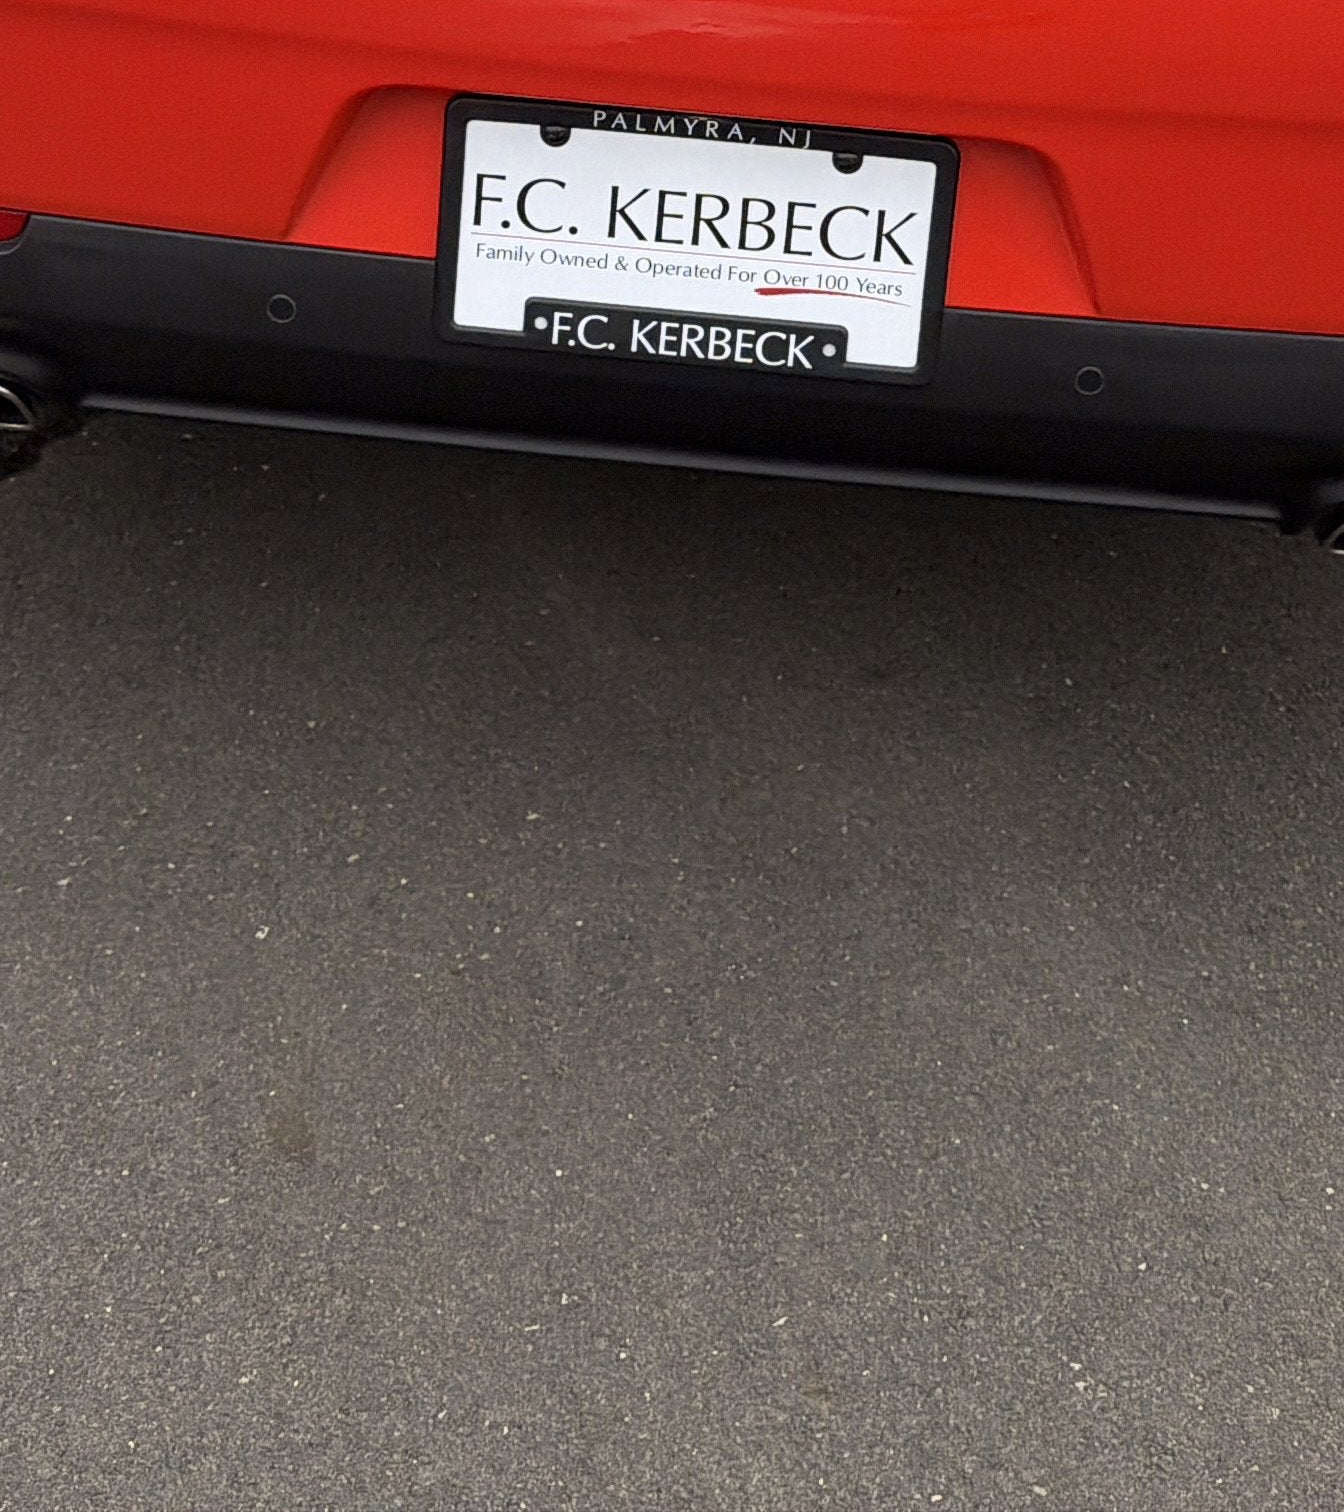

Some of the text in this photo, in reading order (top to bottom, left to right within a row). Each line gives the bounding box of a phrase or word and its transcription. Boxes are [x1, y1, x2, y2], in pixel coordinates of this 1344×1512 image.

[592, 110, 813, 149] PALMYRA, NJ
[471, 172, 919, 266] F.C. KERBECK
[475, 243, 904, 297] Family Owned & Operated For Over 100 Years
[550, 311, 815, 370] F.C. KERBECK
